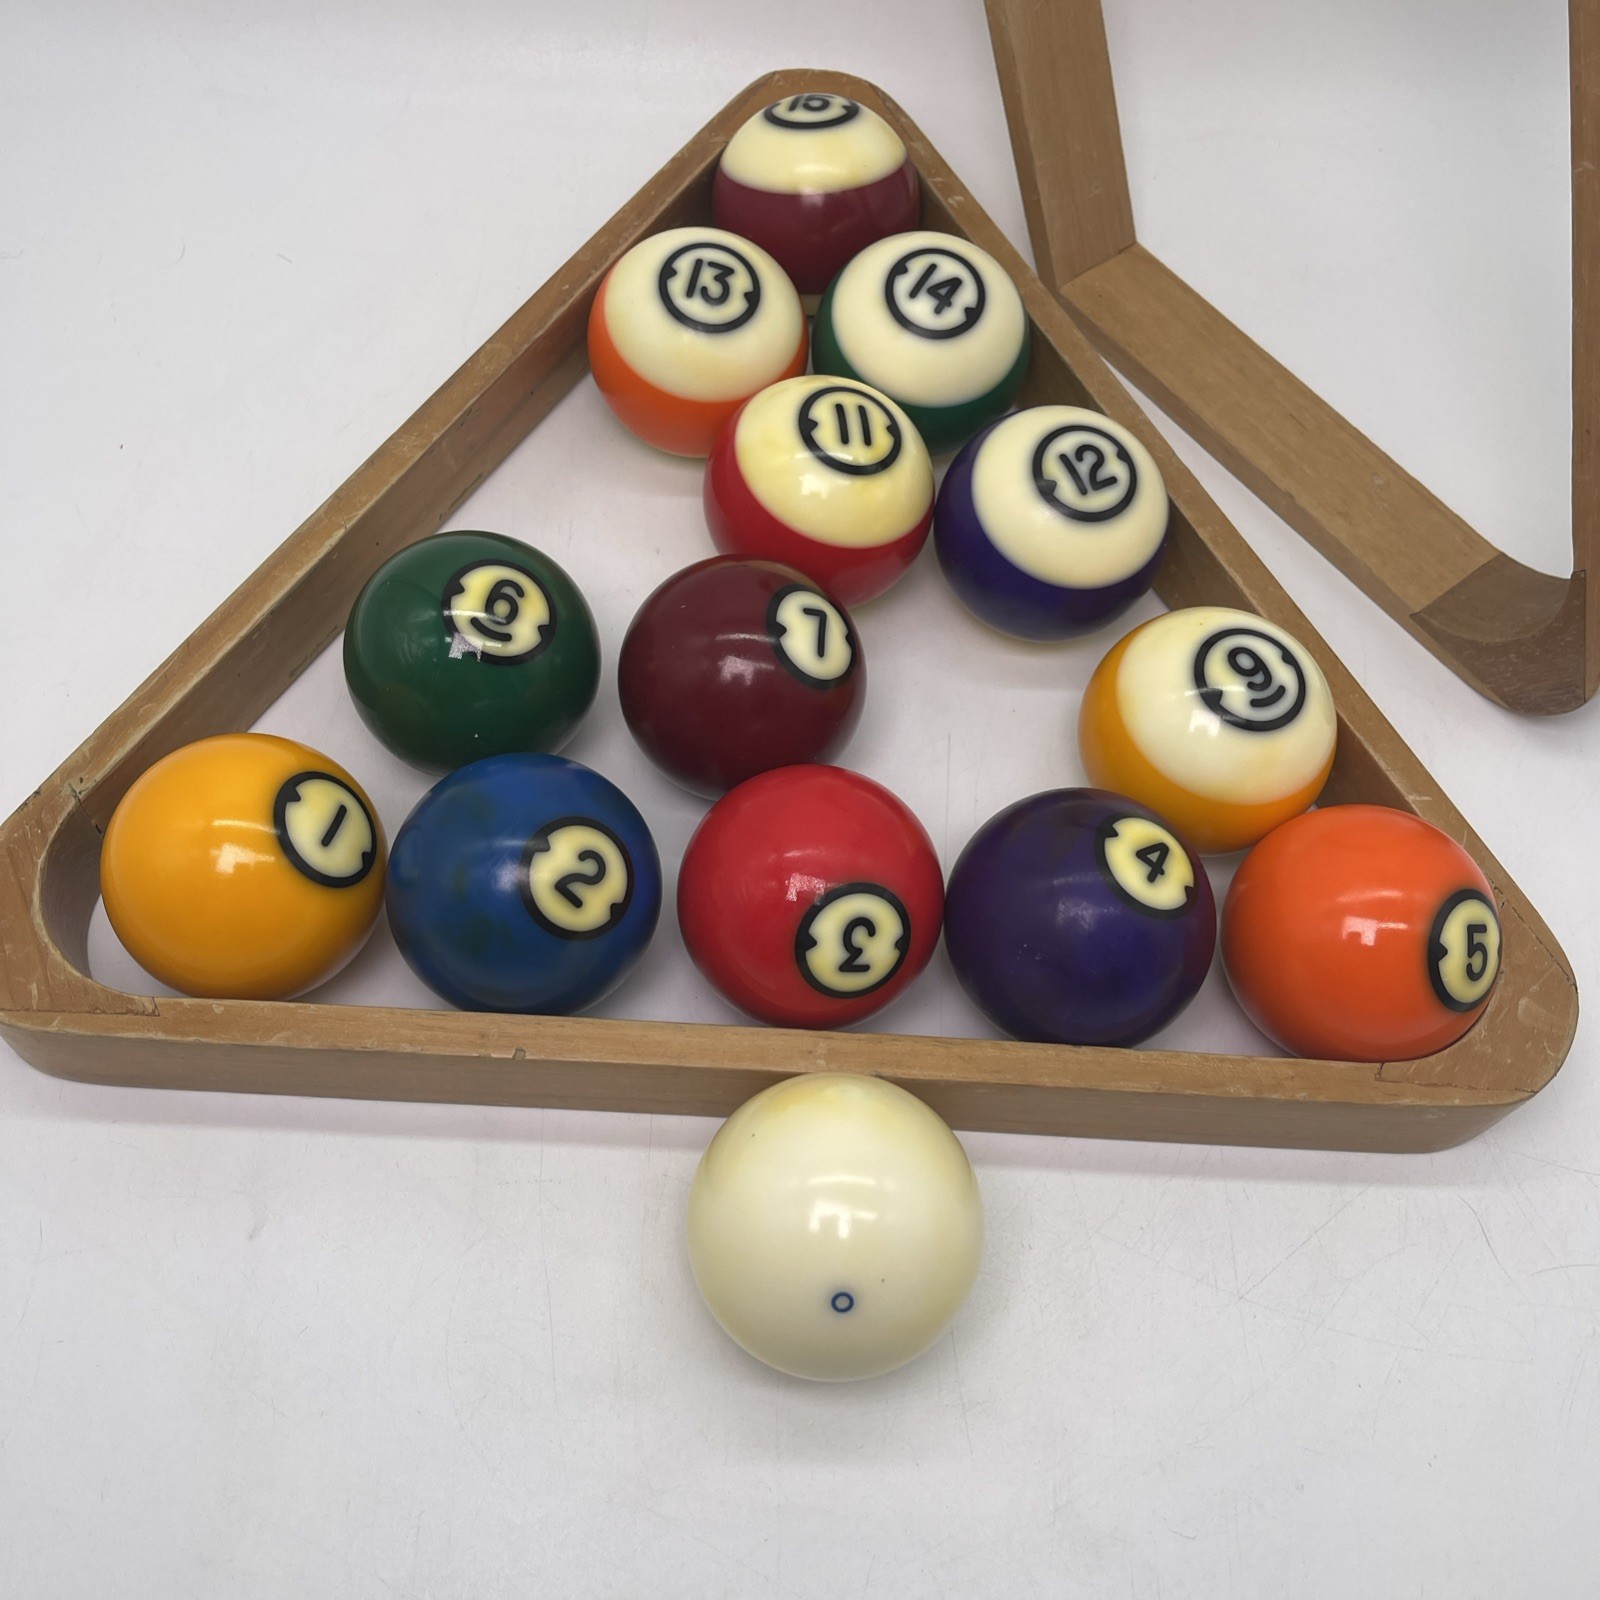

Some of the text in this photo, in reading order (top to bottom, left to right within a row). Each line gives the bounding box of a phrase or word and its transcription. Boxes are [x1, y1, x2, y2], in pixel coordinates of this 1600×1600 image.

[788, 93, 835, 112] 15
[686, 258, 735, 306] 13
[909, 263, 962, 315] 14
[835, 403, 872, 447] 11
[1059, 443, 1118, 496] 12
[484, 579, 525, 627] 6
[802, 607, 827, 659] 7
[1227, 646, 1272, 693] 9
[321, 804, 347, 848] 1
[554, 849, 606, 909] 2
[1135, 842, 1170, 883] 4
[838, 916, 876, 973] 3
[1466, 923, 1488, 982] 5
